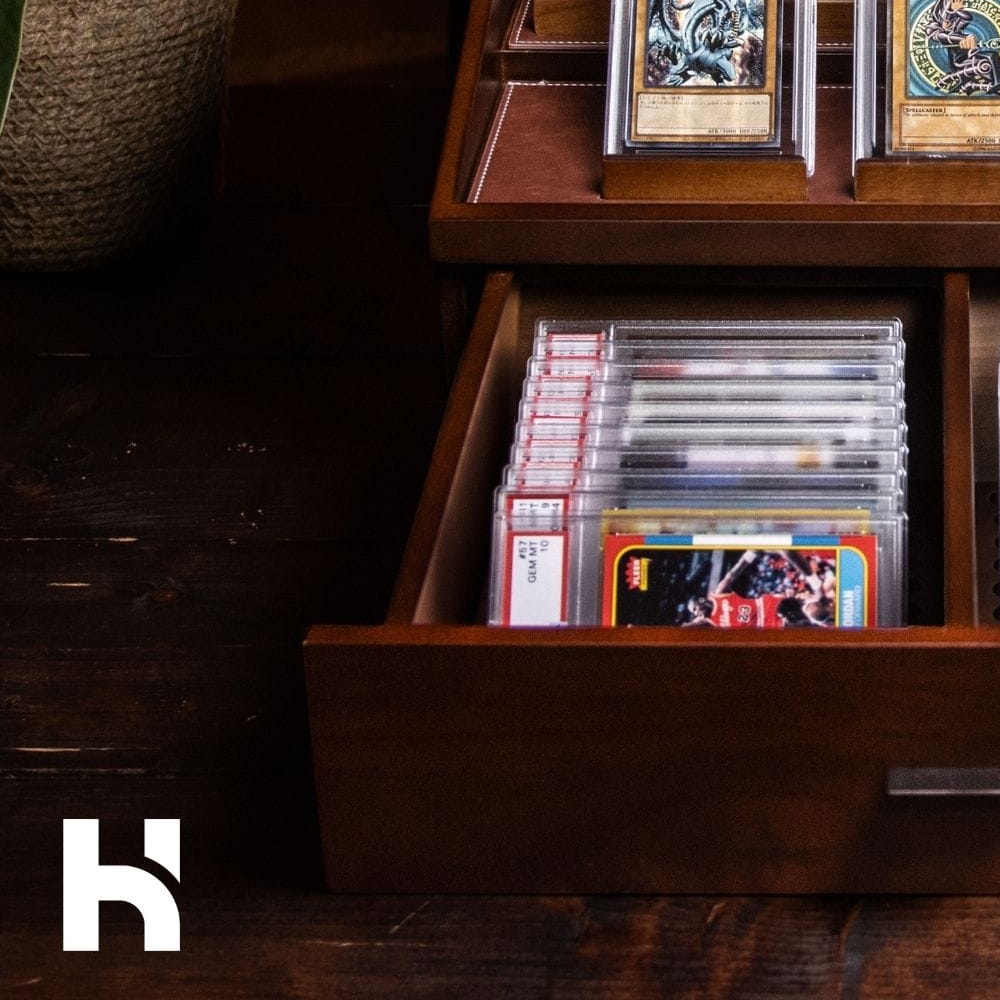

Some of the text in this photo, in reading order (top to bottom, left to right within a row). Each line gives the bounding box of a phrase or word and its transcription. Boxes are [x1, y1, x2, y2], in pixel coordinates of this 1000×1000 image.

[519, 540, 528, 560] #57
[540, 540, 549, 552] 10
[528, 541, 538, 583] GEM MT
[632, 559, 641, 585] FLEER
[737, 605, 751, 623] 23
[843, 590, 855, 627] ORDAN
